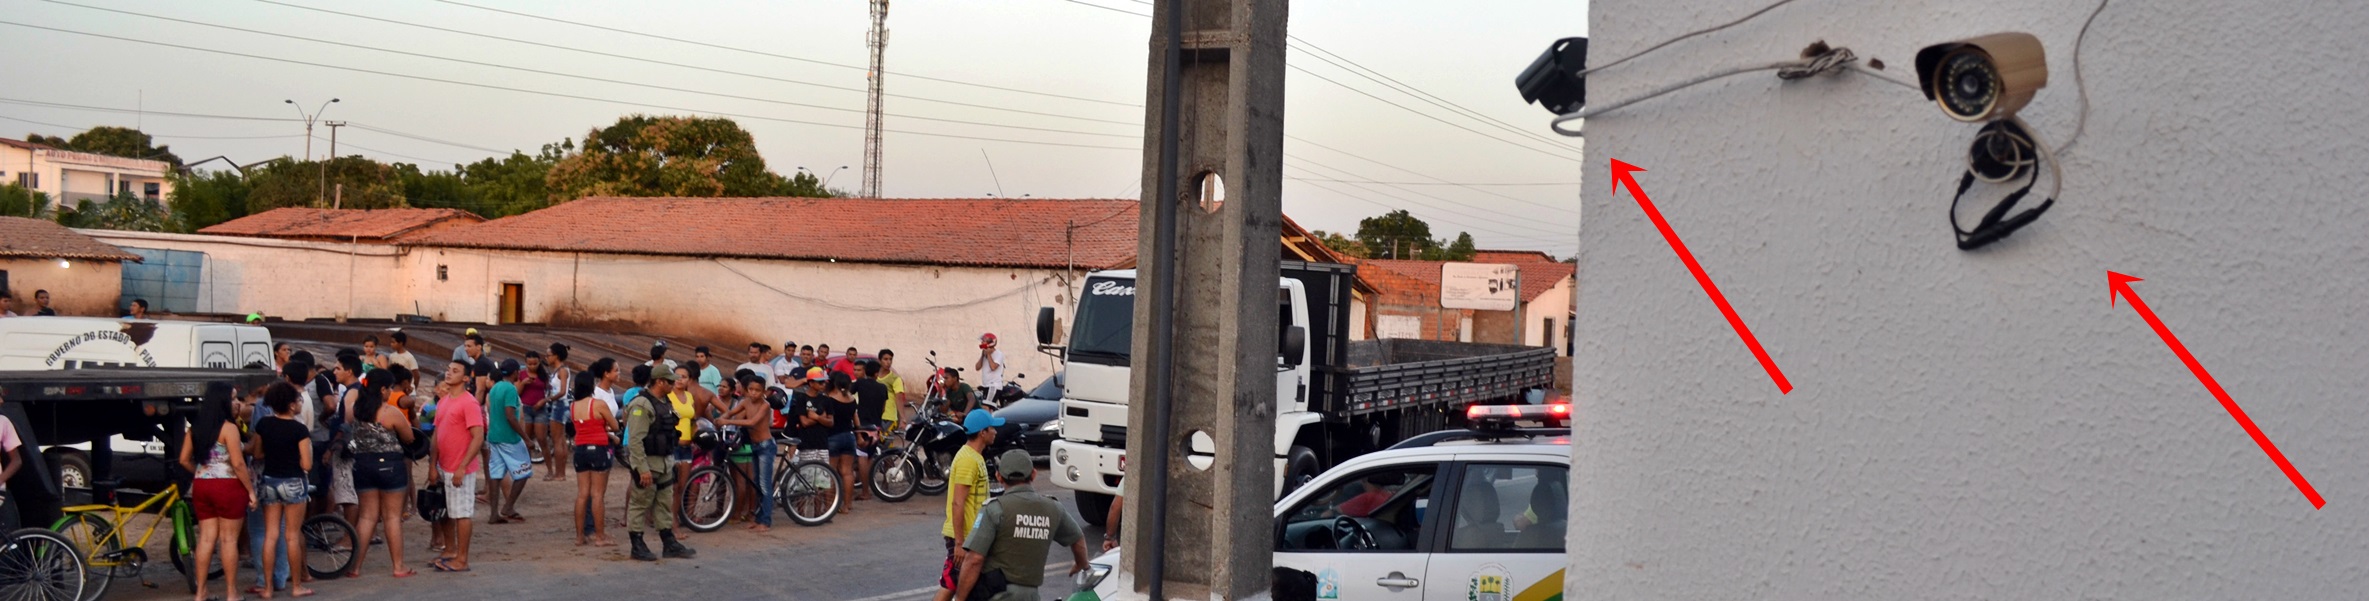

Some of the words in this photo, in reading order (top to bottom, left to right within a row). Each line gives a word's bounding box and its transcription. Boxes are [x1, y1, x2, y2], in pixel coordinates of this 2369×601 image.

[98, 330, 130, 345] ESTADO
[1016, 514, 1050, 527] POLICIA
[1013, 526, 1050, 540] MILITAR
